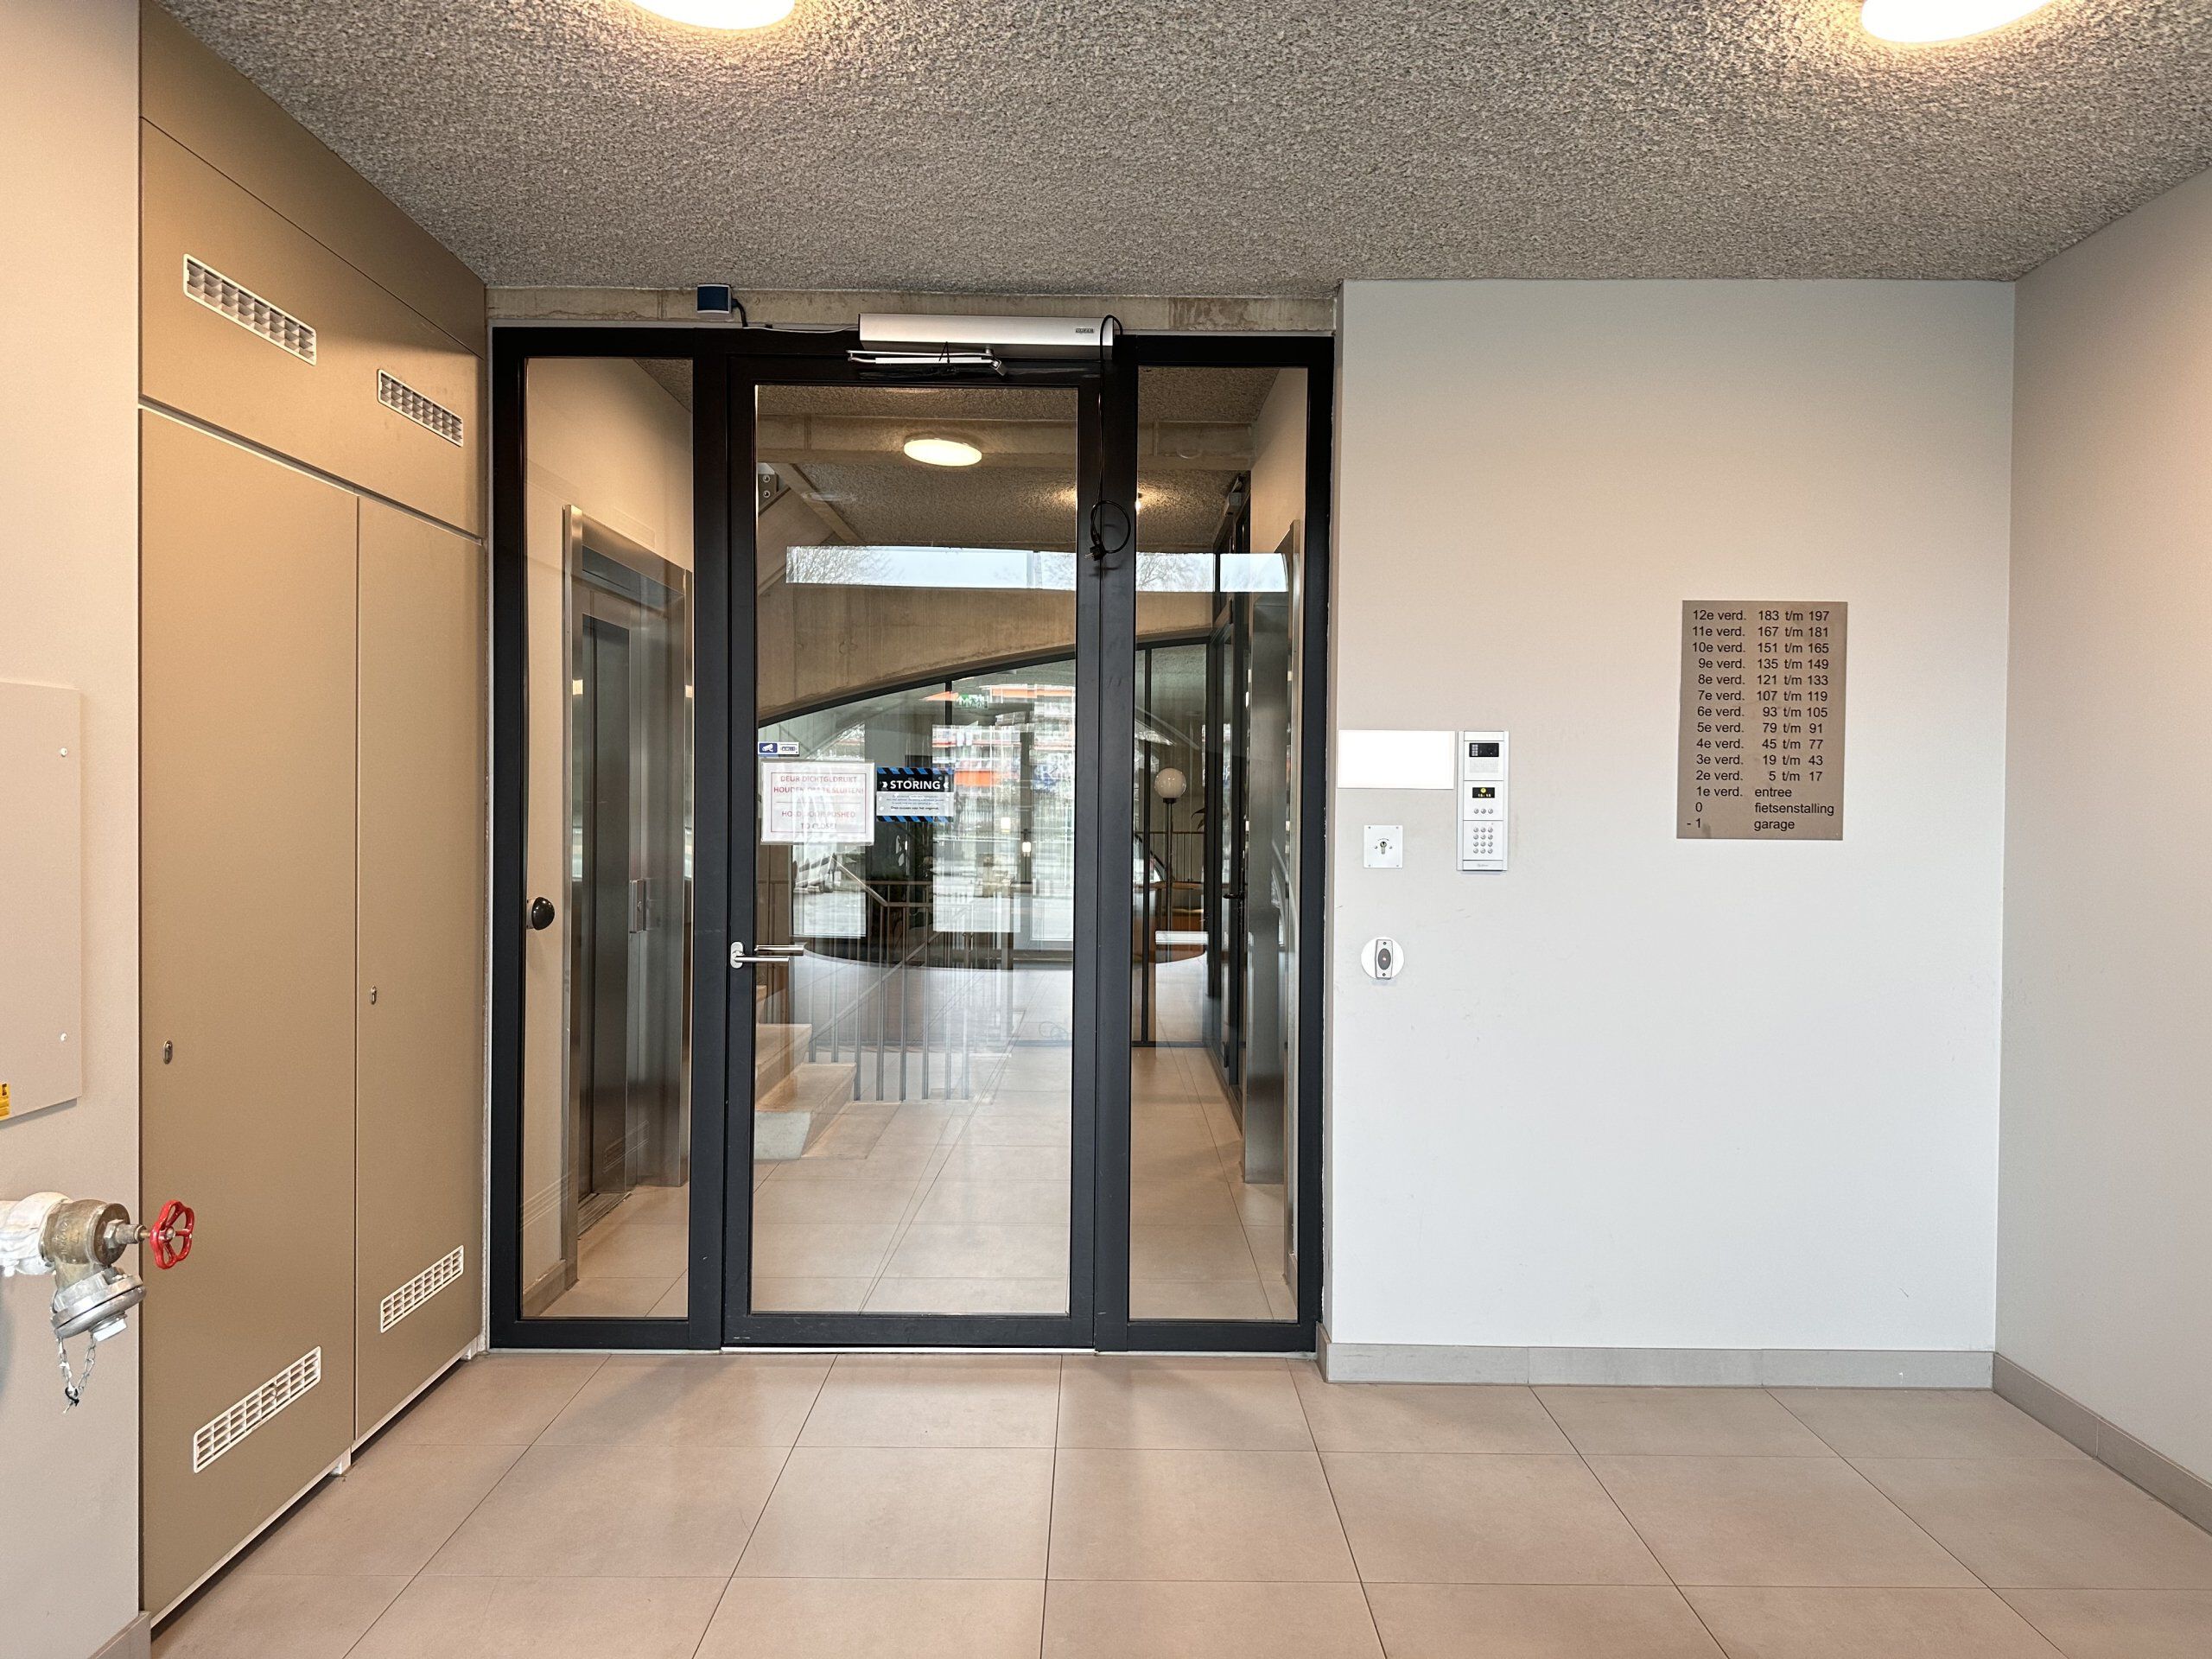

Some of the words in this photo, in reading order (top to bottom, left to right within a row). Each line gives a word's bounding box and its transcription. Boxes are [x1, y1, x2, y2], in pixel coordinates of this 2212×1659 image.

[1694, 610, 1714, 620] 12e
[1718, 610, 1746, 620] verd.
[1758, 610, 1779, 620] 183
[1785, 610, 1803, 621] t/m
[1809, 611, 1829, 621] 197
[1693, 626, 1713, 636] 11e
[1716, 626, 1745, 636] verd.
[1758, 626, 1779, 637] 167
[1785, 626, 1803, 637] t/m
[1808, 627, 1827, 637] 181
[1693, 642, 1713, 652] 10e
[1717, 642, 1745, 652] verd.
[1758, 643, 1777, 652] 151
[1784, 643, 1802, 653] t/m
[1808, 643, 1829, 653] 165
[1699, 658, 1713, 668] 9e
[1717, 658, 1745, 669] verd.
[1758, 658, 1778, 669] 135
[1784, 658, 1802, 669] t/m
[1808, 659, 1829, 670] 149
[1698, 674, 1713, 684] 8e
[1716, 675, 1745, 684] verd.
[1757, 675, 1777, 684] 121
[1784, 675, 1802, 685] t/m
[1808, 675, 1828, 685] 133
[1698, 690, 1713, 700] 7e
[1716, 690, 1745, 701] verd.
[1757, 690, 1777, 701] 107
[1783, 690, 1802, 701] t/m
[1808, 691, 1827, 702] 119
[1697, 706, 1712, 716] 6e
[1715, 707, 1744, 717] verd.
[1763, 707, 1777, 717] 93
[1783, 707, 1802, 717] t/m
[1807, 707, 1827, 717] 105
[1697, 722, 1712, 732] 5e
[1715, 722, 1744, 733] verd.
[1763, 722, 1777, 733] 79
[1783, 722, 1801, 733] t/m
[1809, 723, 1821, 734] 91
[1696, 738, 1712, 748] 4e
[1715, 738, 1744, 748] verd.
[1762, 739, 1777, 749] 45
[1783, 739, 1801, 749] t/m
[1809, 740, 1823, 749] 77
[1696, 754, 1711, 764] 3e
[1714, 754, 1744, 765] verd.
[1763, 754, 1777, 765] 19
[1783, 754, 1800, 765] t/m
[1808, 755, 1823, 766] 43
[1696, 770, 1710, 780] 2e
[1713, 771, 1743, 780] verd.
[1768, 771, 1776, 781] 5
[1782, 771, 1800, 781] t/m
[1809, 772, 1822, 781] 17
[890, 780, 941, 790] STORING
[1697, 786, 1710, 797] 1e
[1714, 786, 1743, 797] verd.
[1755, 786, 1792, 797] entree
[1695, 802, 1702, 812] 0
[1755, 803, 1834, 816] fietsenstalling
[1754, 820, 1795, 832] garage
